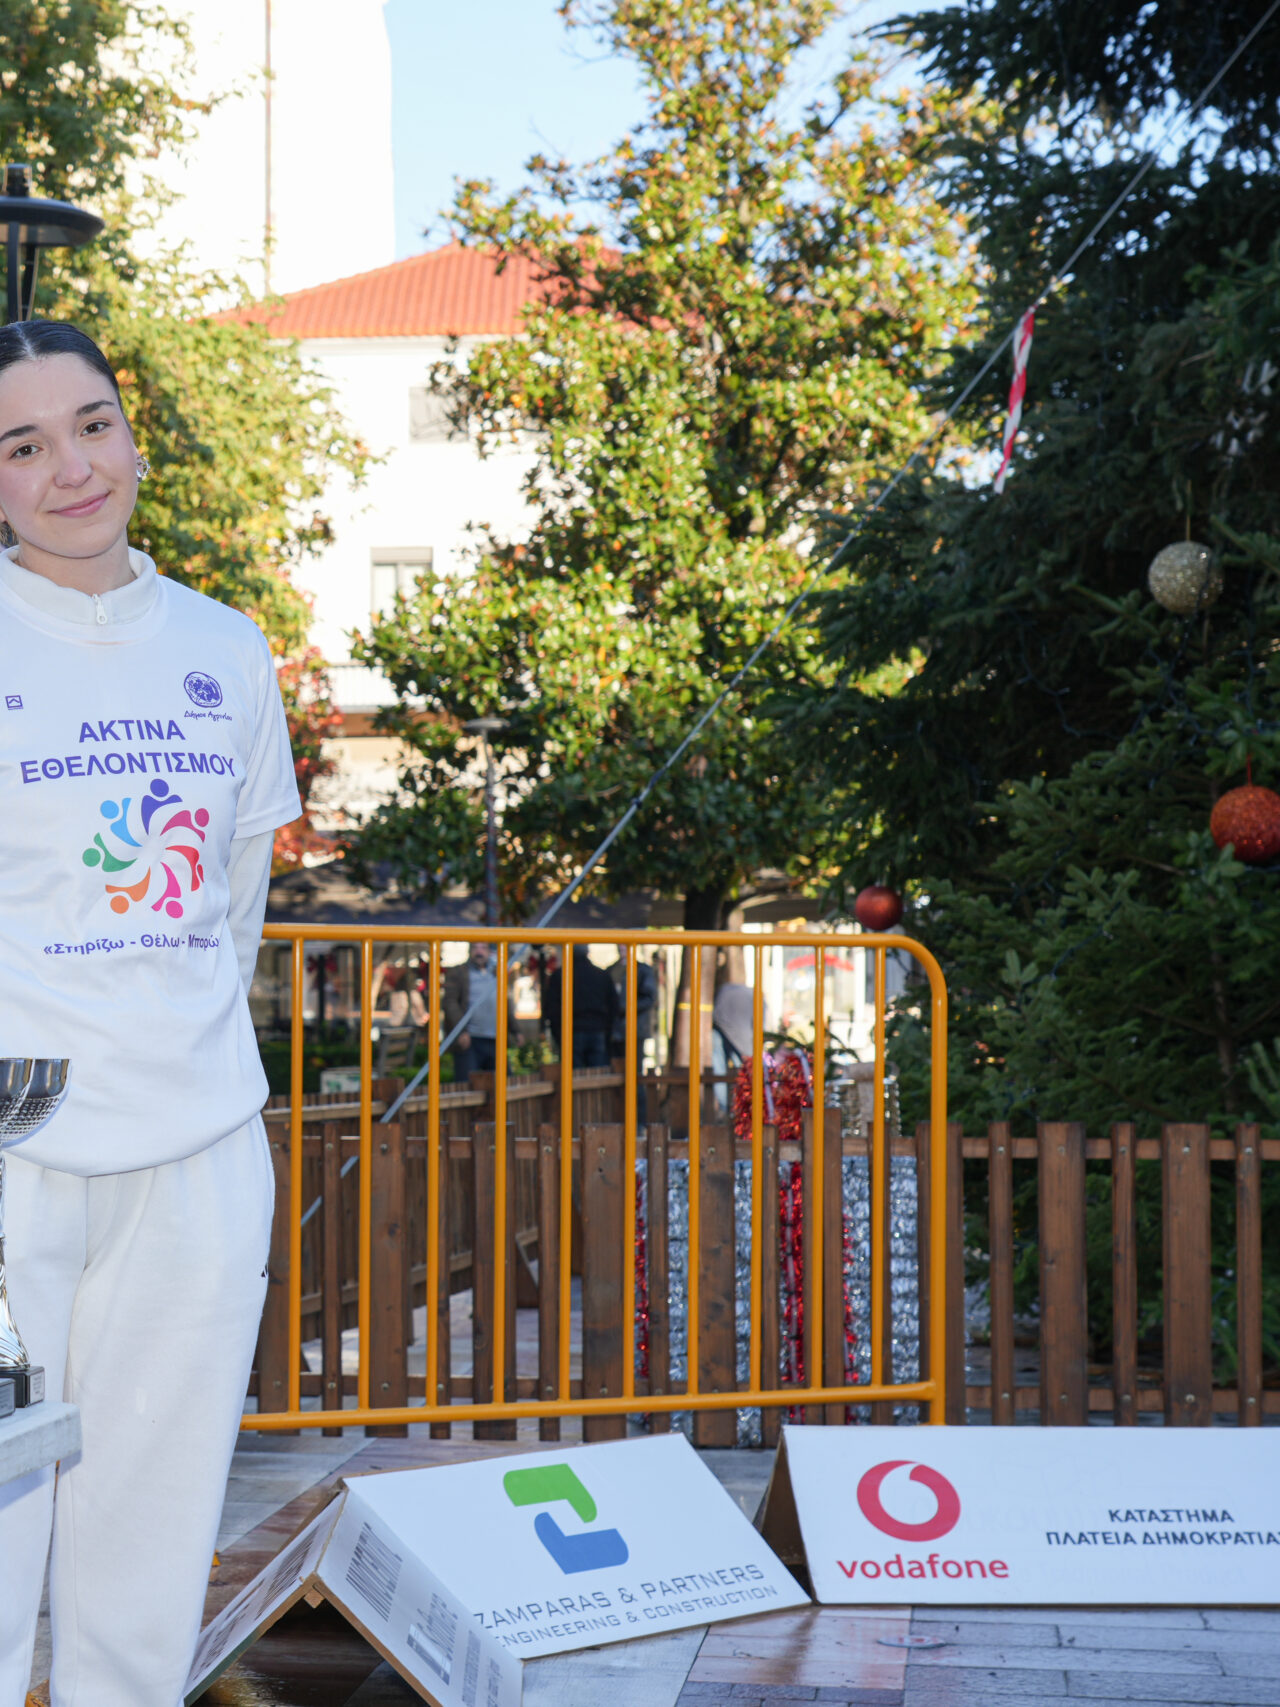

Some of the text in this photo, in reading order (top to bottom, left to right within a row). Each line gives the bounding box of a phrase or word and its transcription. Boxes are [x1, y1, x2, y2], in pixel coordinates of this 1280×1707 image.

[79, 720, 186, 743] ΑΚΤΙΝΑ
[20, 752, 236, 784] ΕΘΕΛΟΝΤΙΣΜΟΥ
[43, 938, 125, 955] «Στηρίζω
[141, 934, 180, 948] Θέλω
[1108, 1508, 1235, 1523] ΚΑΤΑΣΤΗΜΑ
[1046, 1531, 1280, 1545] ΠΛΑΤΕΙΑ ΔΗΜΟΚΡΑΤΙΑ
[836, 1553, 1009, 1579] vodafone
[617, 1586, 636, 1604] &
[640, 1564, 765, 1599] PARTNERS
[627, 1610, 640, 1624] &
[642, 1585, 779, 1620] CONSTRUCTION
